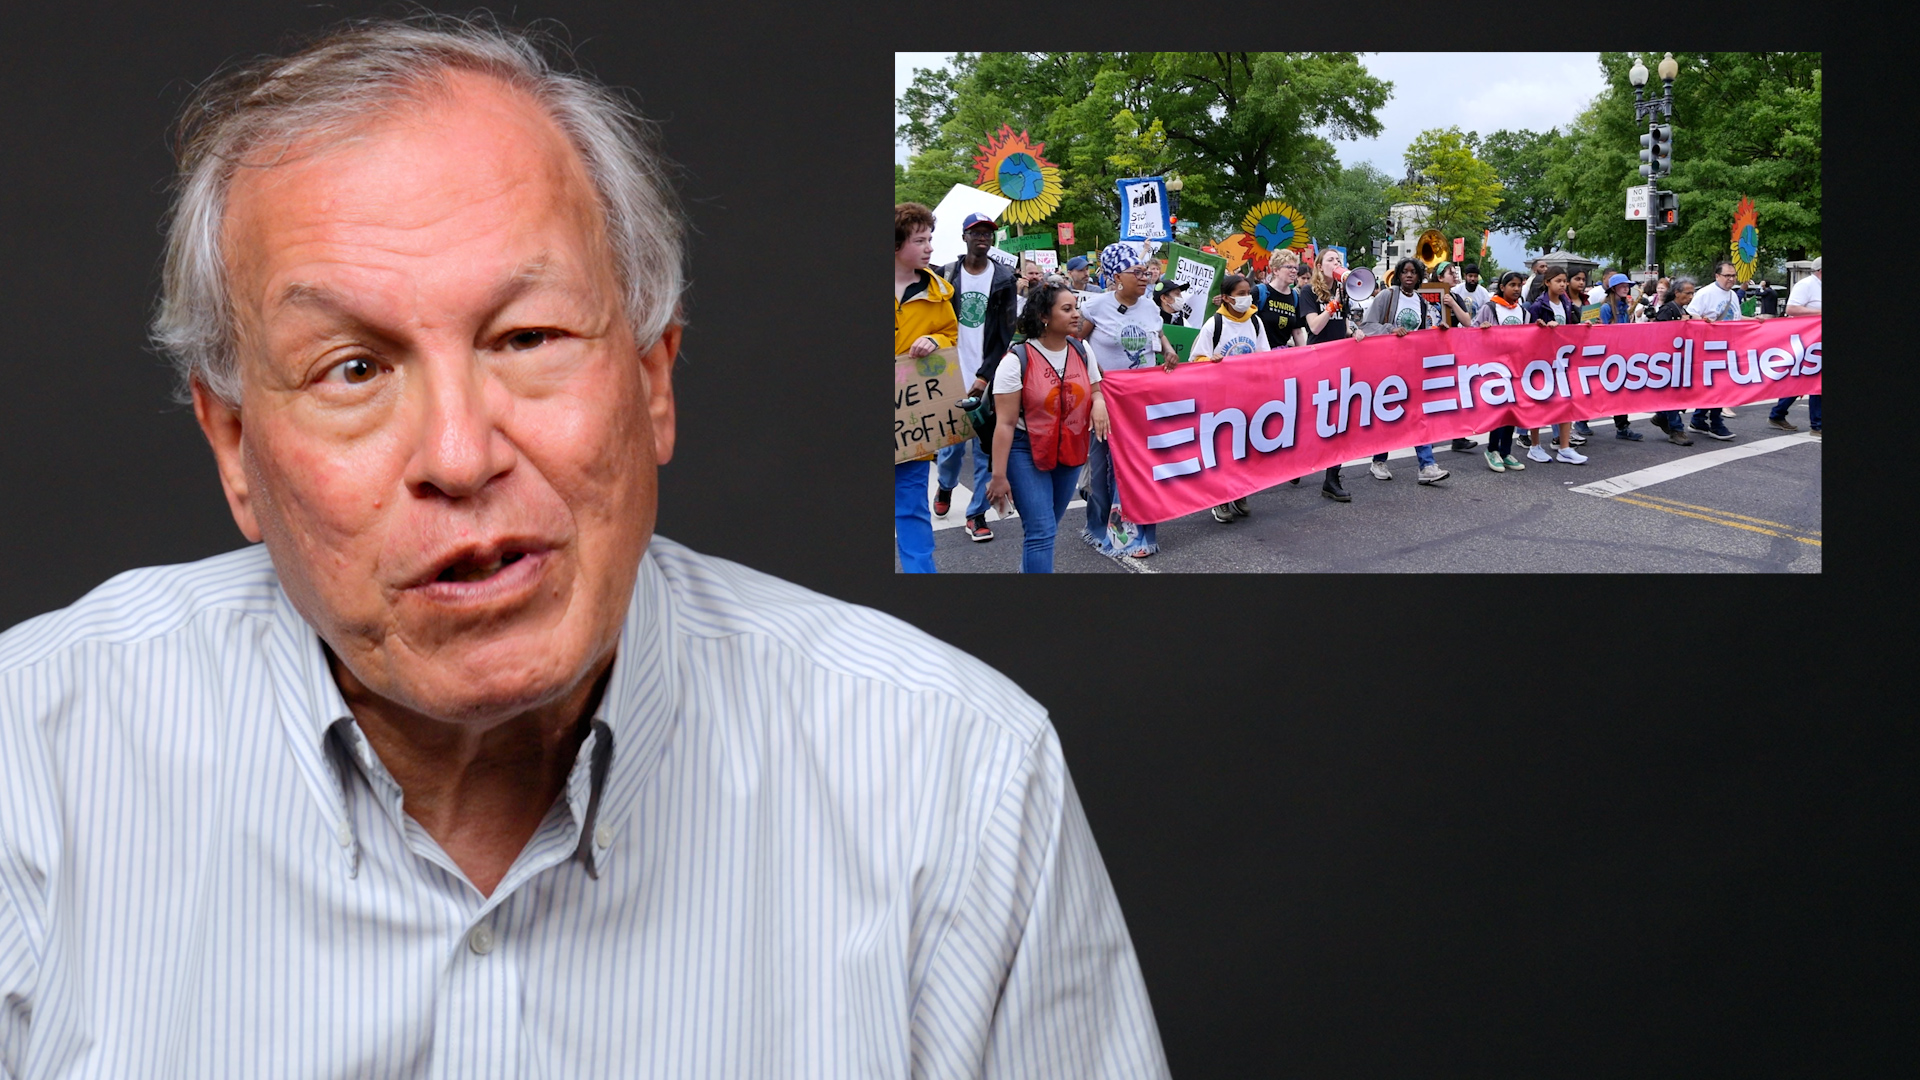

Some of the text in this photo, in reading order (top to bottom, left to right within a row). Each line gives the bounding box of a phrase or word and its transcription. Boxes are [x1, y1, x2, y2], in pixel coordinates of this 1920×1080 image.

[1178, 259, 1213, 279] CLIMATE
[1176, 271, 1209, 288] JUSTICE
[1268, 300, 1296, 313] SUNRIS
[1145, 334, 1822, 481] End the Era of Fossil Fuels
